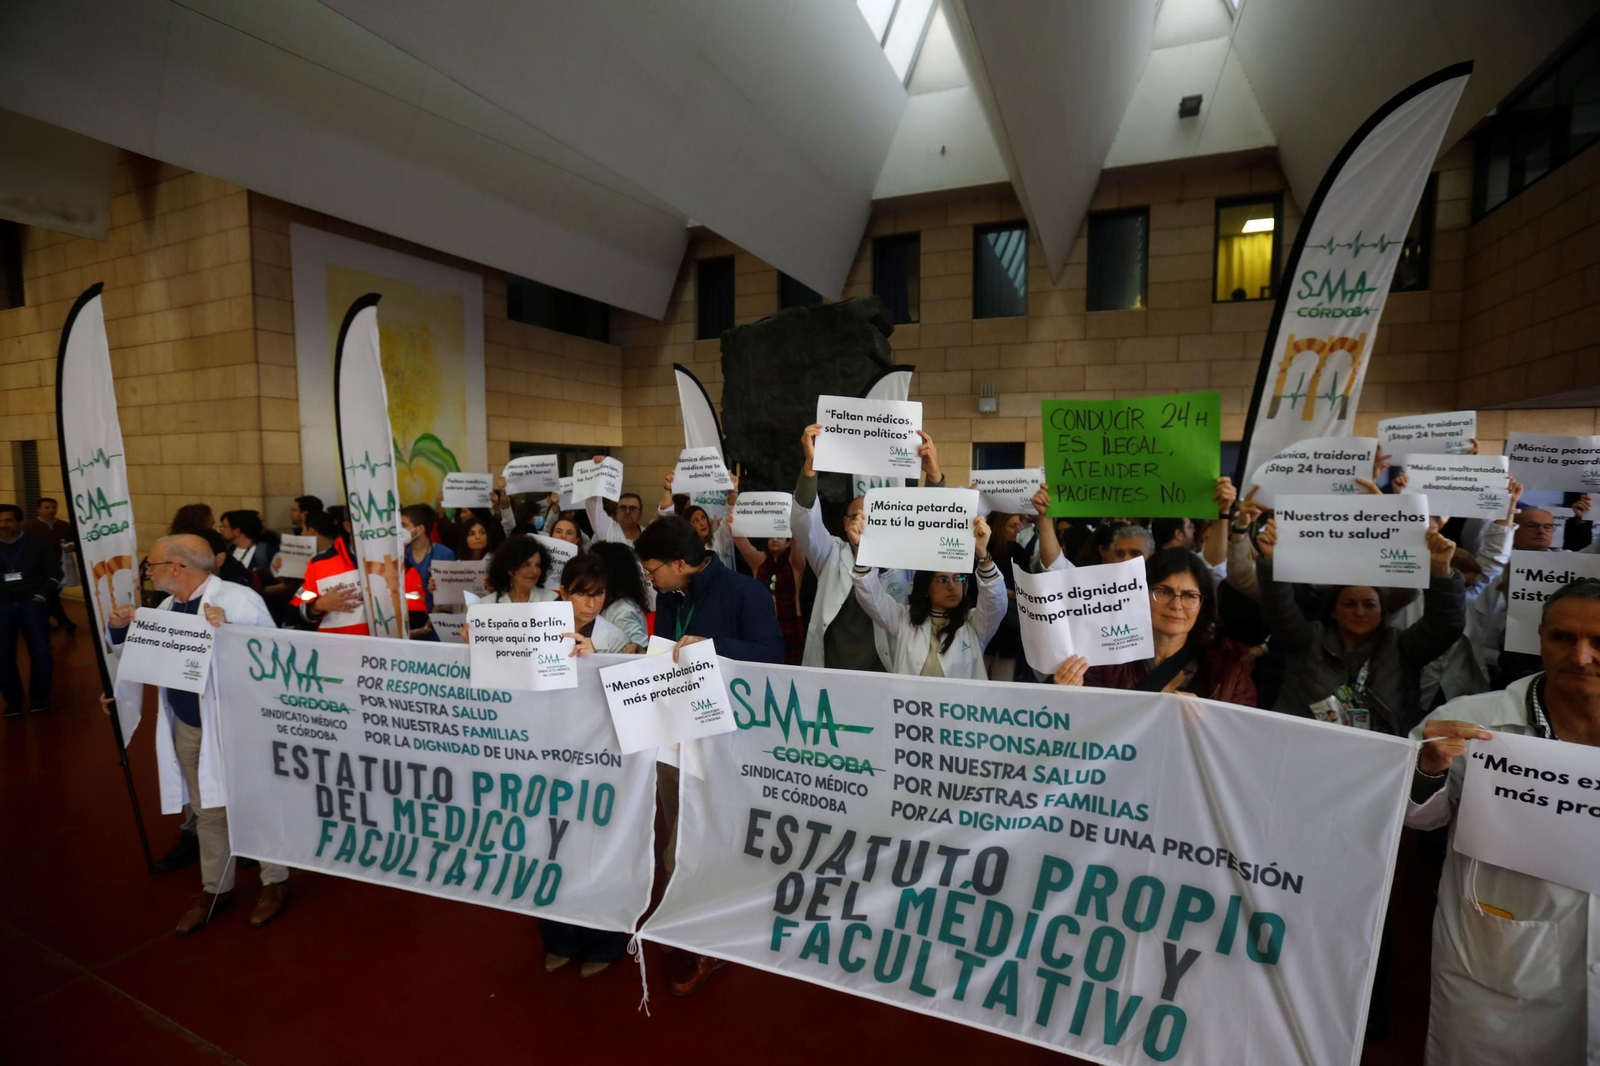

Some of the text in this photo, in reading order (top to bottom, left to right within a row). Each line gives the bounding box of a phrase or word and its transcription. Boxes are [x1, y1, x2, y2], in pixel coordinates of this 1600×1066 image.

[825, 409, 913, 426] “Faltan médicos,
[1160, 401, 1191, 429] 24
[824, 424, 914, 439] sobran políticos”
[1057, 434, 1088, 453] ES
[1313, 451, 1371, 461] traidora!
[1509, 453, 1558, 464] haz tú la
[1513, 443, 1559, 454] ¡Mónica
[1062, 458, 1162, 478] ATENDER
[1297, 464, 1313, 474] 24
[1315, 465, 1356, 476] horas!
[736, 507, 753, 515] vidas
[870, 501, 967, 514] ¡Mónica petarda,
[1276, 510, 1426, 522] “Nuestros derechos
[867, 515, 969, 530] haz tú la guardia!
[1299, 528, 1400, 540] son tu salud”
[1067, 578, 1143, 600] dignidad,
[133, 619, 213, 641] “Médico quemado,
[470, 619, 486, 628] “De
[487, 619, 520, 631] España
[530, 618, 566, 628] Berlín,
[127, 633, 212, 654] sistema colapsado”
[474, 634, 503, 645] porque
[505, 634, 526, 645] aquí
[544, 633, 565, 643] hay
[495, 648, 539, 659] porvenir”
[361, 655, 471, 680] POR FORMACIÓN
[605, 660, 714, 692] “Menos explotación,
[357, 675, 513, 703] POR RESPONSABILIDAD
[622, 676, 705, 706] más protección”
[261, 707, 347, 731] SINDICATO MÉDICO
[360, 694, 498, 721] POR NUESTRA SALUD
[893, 699, 1070, 731] POR FORMACIÓN
[276, 723, 338, 742] DE CÓRDOBA
[362, 712, 530, 742] POR NUESTRAS FAMILIAS
[364, 731, 622, 768] POR LA DIGNIDAD DE UNA PROFESIÓN
[894, 723, 1137, 762] POR RESPONSABILIDAD
[894, 748, 1106, 786] POR NUESTRA SALUD
[1472, 751, 1570, 786] “Menos
[272, 741, 616, 827] ESTATUTO PROPIO
[740, 764, 868, 797] SINDICATO MÉDICO
[762, 785, 847, 814] DE CÓRDOBA
[893, 774, 1149, 822] POR NUESTRAS FAMILIAS
[1494, 785, 1549, 807] más
[316, 784, 570, 861] DEL MÉDICO Y
[891, 800, 1304, 895] POR LA DIGNIDAD DE UNA PROFESIÓN
[315, 819, 563, 907] FACULTATIVO
[743, 807, 1287, 967] ESTATUTO PROPIO
[772, 872, 1202, 1002] DEL MÉDICO Y
[769, 917, 1188, 1063] FACULTATIVO
